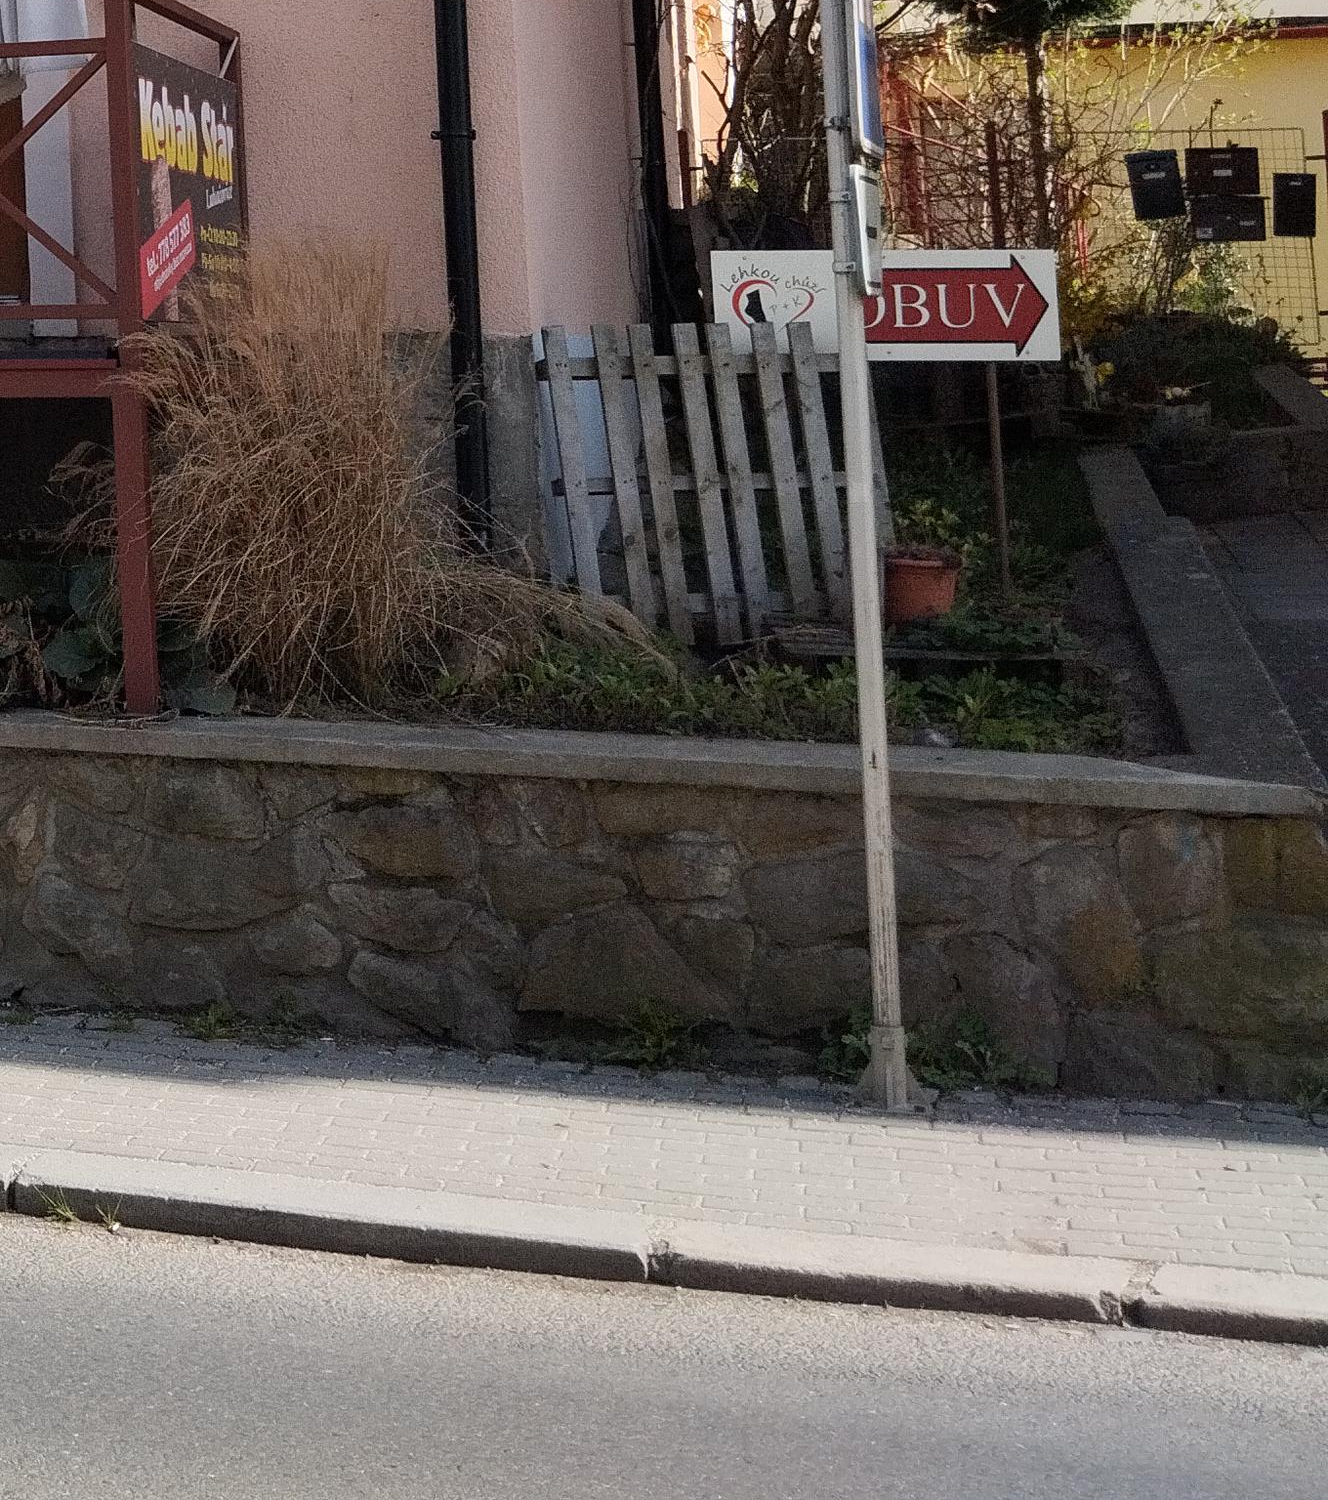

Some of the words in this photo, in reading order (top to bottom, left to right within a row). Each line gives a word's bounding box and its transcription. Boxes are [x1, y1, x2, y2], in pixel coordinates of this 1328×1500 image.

[138, 78, 198, 174] Kebab
[201, 100, 234, 184] Star
[720, 263, 781, 293] Lehkou
